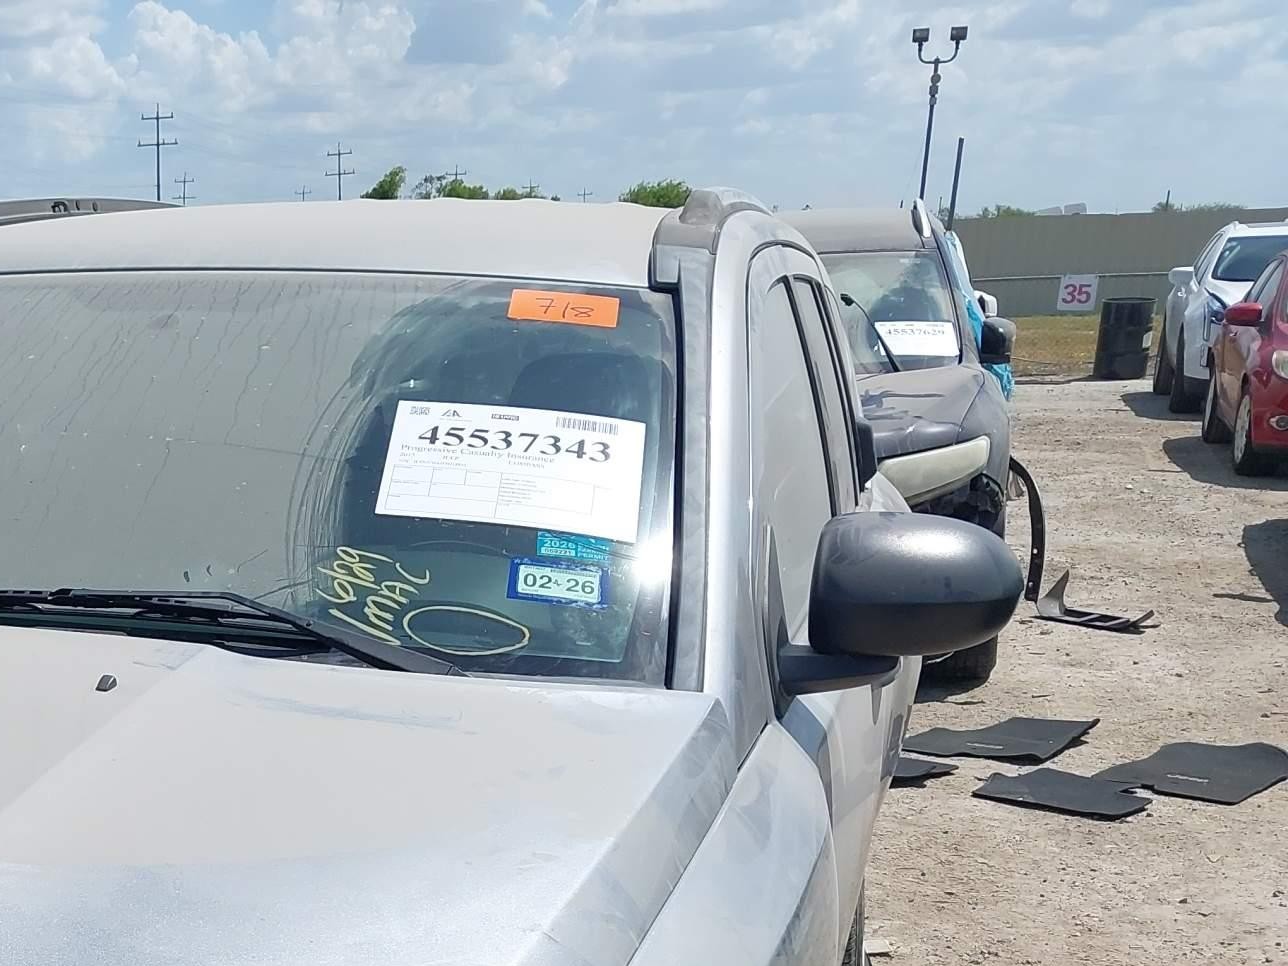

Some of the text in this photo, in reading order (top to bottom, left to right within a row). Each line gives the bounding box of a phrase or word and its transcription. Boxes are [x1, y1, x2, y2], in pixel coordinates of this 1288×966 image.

[1061, 283, 1092, 304] 35
[418, 425, 612, 463] 45537343
[543, 539, 576, 549] 2026
[523, 572, 553, 590] 02
[565, 578, 596, 595] 26
